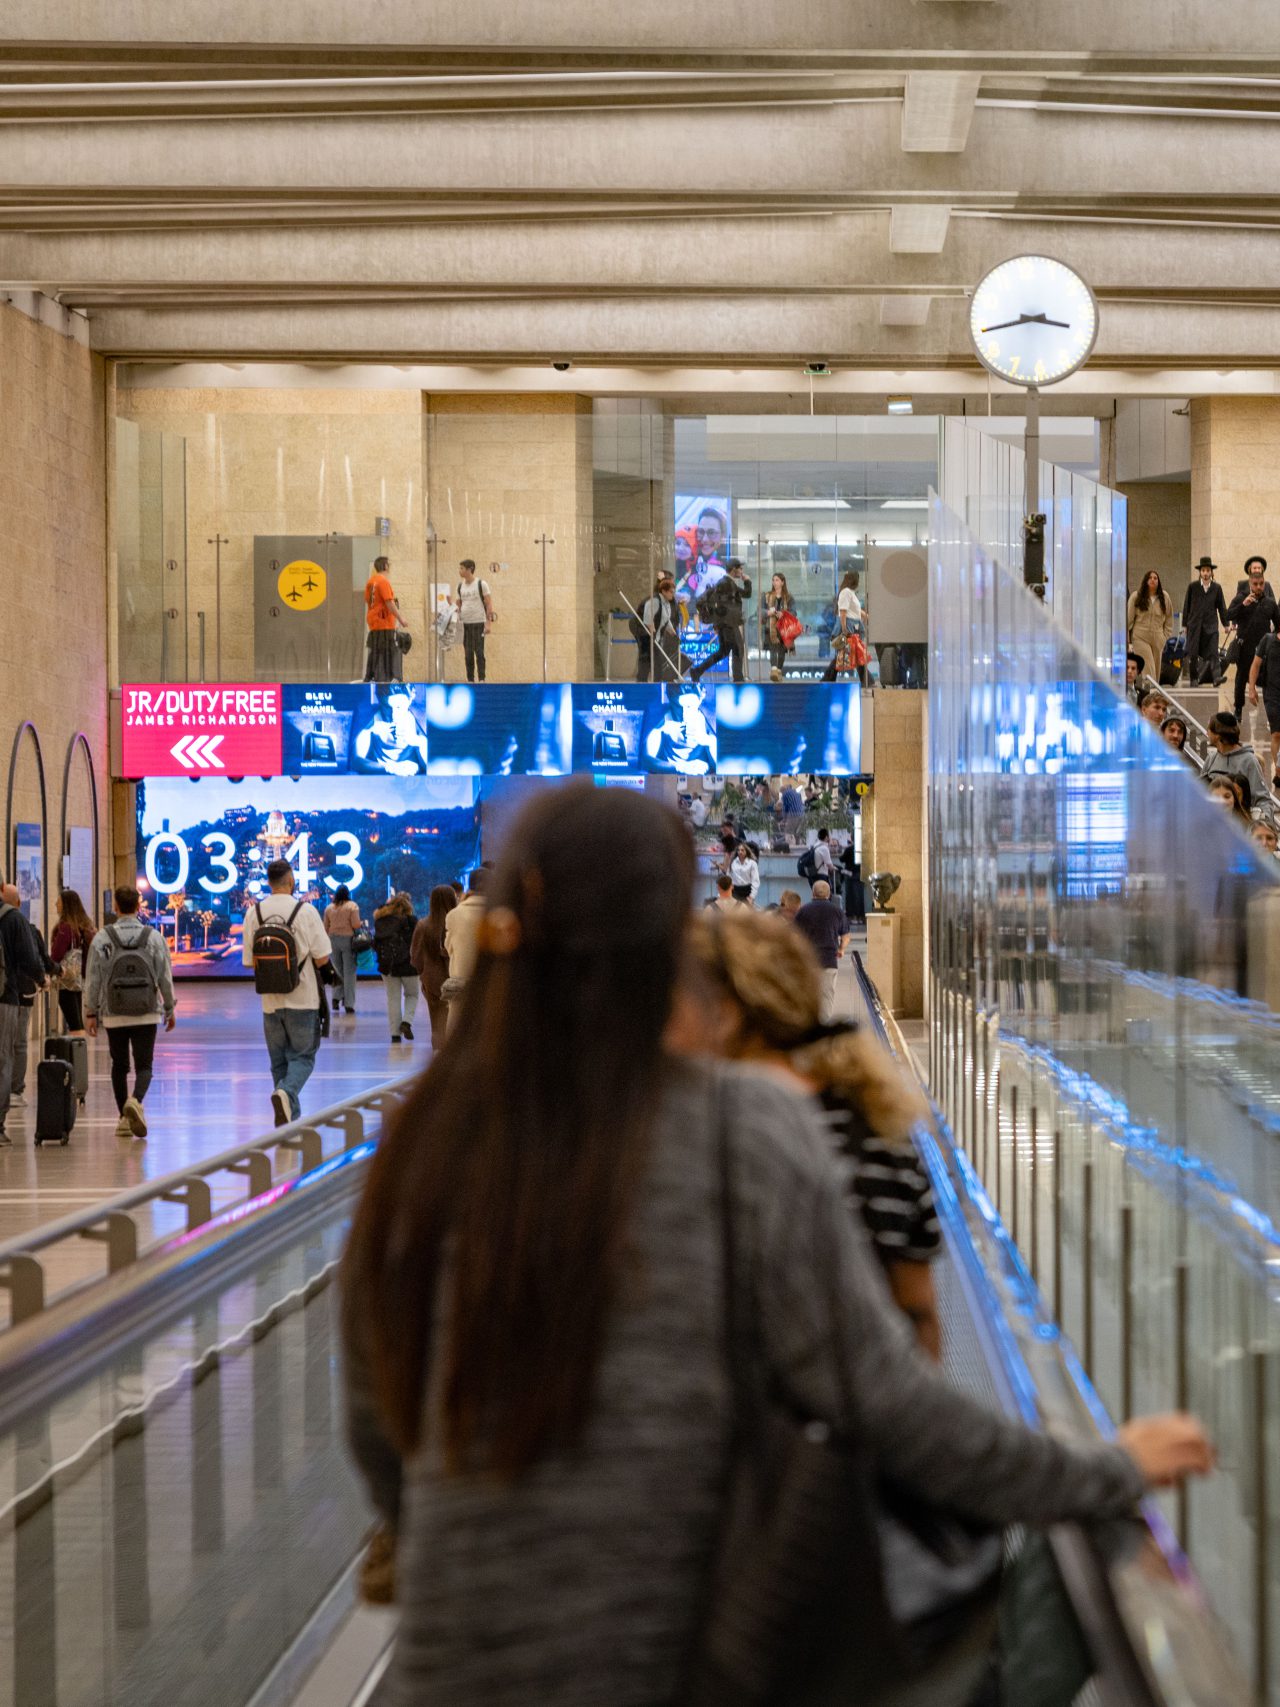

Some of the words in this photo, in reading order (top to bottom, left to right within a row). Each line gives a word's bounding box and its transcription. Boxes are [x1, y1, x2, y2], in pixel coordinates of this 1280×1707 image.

[305, 692, 332, 701] BLEU
[596, 691, 623, 700] BLEU
[301, 705, 337, 714] CHANEL
[592, 704, 628, 714] CHANEL
[127, 714, 174, 726] JAMES
[182, 714, 277, 726] RICHARDSON
[145, 831, 364, 894] 03:43
